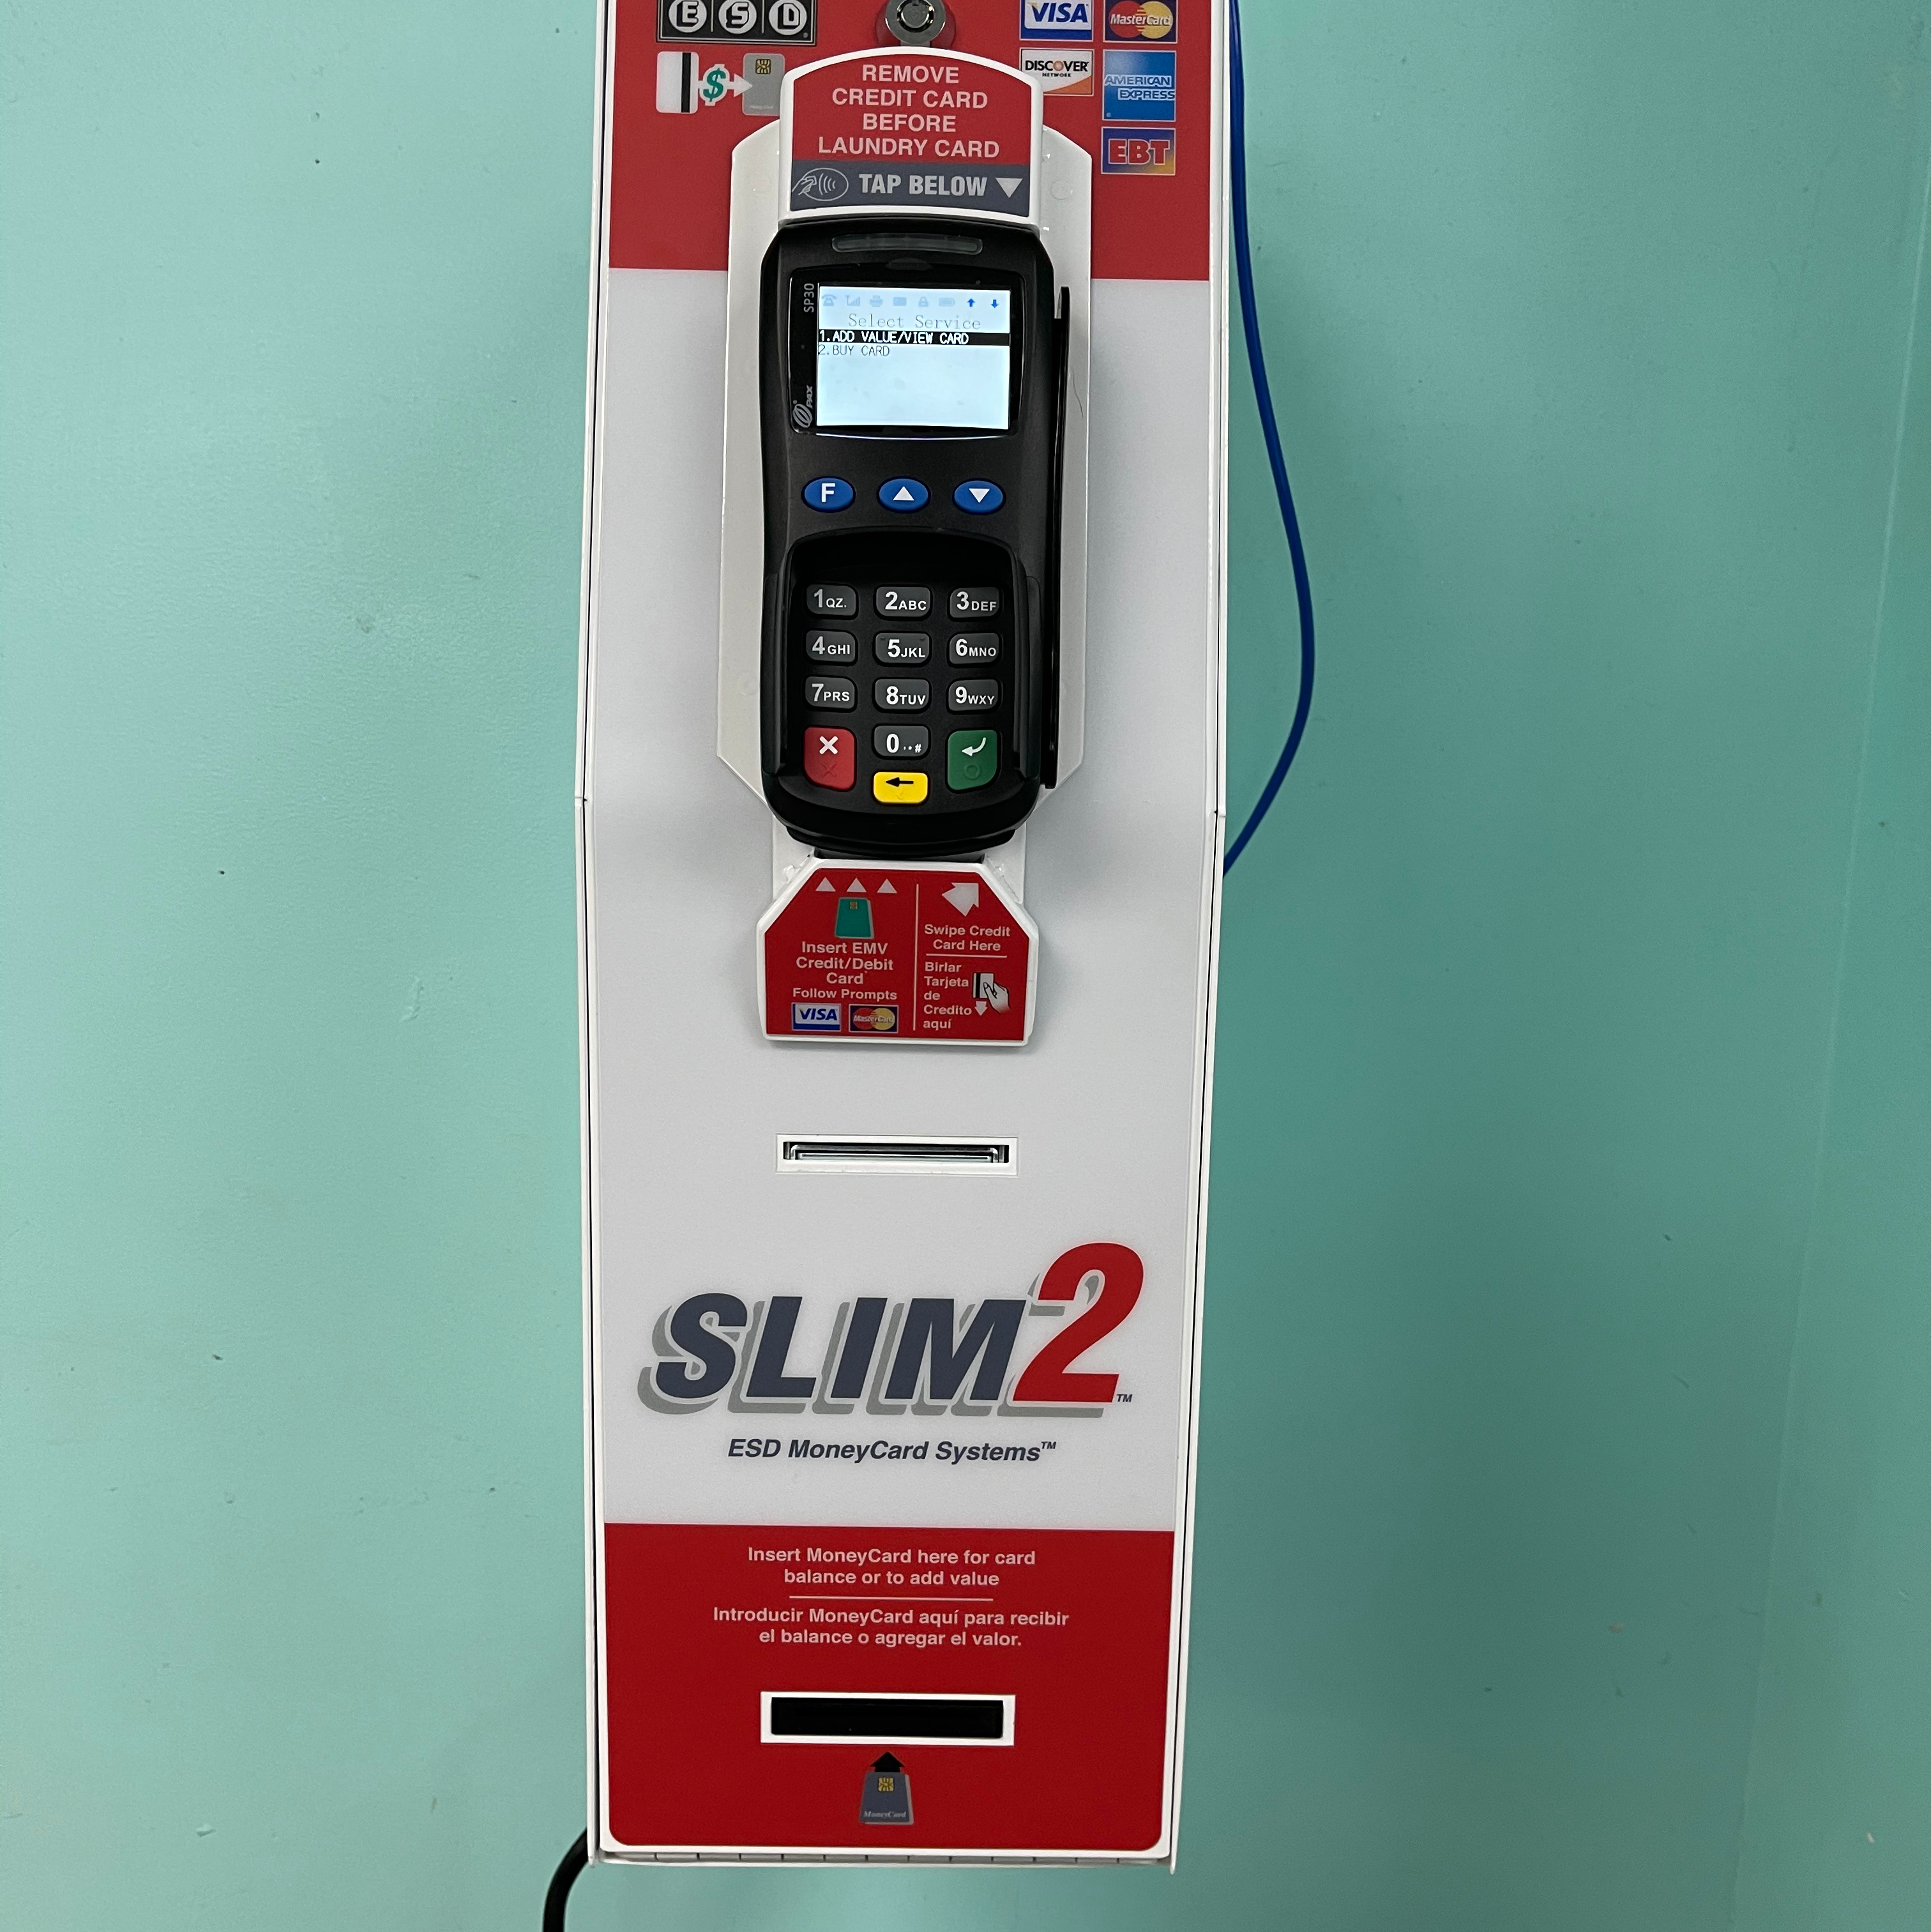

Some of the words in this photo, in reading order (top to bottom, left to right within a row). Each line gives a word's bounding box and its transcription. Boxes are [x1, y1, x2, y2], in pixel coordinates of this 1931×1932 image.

[1028, 3, 1089, 23] VISA
[1110, 13, 1172, 26] MasterCard
[1025, 60, 1089, 72] DISCOVER
[862, 65, 959, 84] REMOVE
[1105, 75, 1171, 86] AMERICAN
[832, 88, 916, 107] CREDIT
[923, 91, 988, 109] CARD
[1119, 89, 1175, 100] EXPRESS
[863, 113, 956, 132] BEFORE
[819, 137, 927, 155] LAUNDRY
[934, 140, 999, 158] CARD
[1109, 139, 1170, 165] EBT
[859, 174, 901, 194] TAP
[909, 176, 987, 196] BELOW
[804, 283, 814, 313] SP30
[848, 313, 904, 328] Select
[915, 314, 981, 330] Service
[819, 330, 855, 343] 1.ADD
[862, 330, 933, 344] VALUE/VIEW
[940, 332, 969, 345] CARD
[818, 345, 854, 356] 2.BUY
[861, 346, 890, 356] CARD
[821, 483, 835, 503] F
[924, 924, 966, 938] Swipe
[969, 925, 1010, 937] Credit
[801, 941, 847, 954] Insert
[852, 943, 888, 955] EMV
[933, 939, 965, 951] Card
[969, 940, 1001, 952] Here
[796, 957, 893, 971] Credit/Debit
[925, 961, 962, 973] Birlar
[826, 972, 863, 985] Card
[924, 977, 969, 989] Tarjeta
[793, 987, 837, 999] Follow
[842, 989, 897, 1003] Prompts
[923, 991, 940, 1001] de
[799, 1008, 837, 1021] VISA
[923, 1005, 972, 1016] Credito
[923, 1018, 951, 1031] aquí
[728, 1438, 781, 1457] ESD
[788, 1439, 929, 1464] MoneyCard
[748, 1547, 801, 1563] Insert
[806, 1548, 912, 1566] MoneyCard
[918, 1549, 958, 1564] here
[964, 1550, 989, 1564] for
[994, 1551, 1036, 1565] card
[784, 1569, 856, 1584] balance
[862, 1573, 881, 1585] or
[886, 1572, 904, 1585] to
[910, 1571, 944, 1585] add
[950, 1572, 1000, 1586] value
[713, 1607, 804, 1622] Introducir
[809, 1608, 914, 1627] MoneyCard
[919, 1610, 959, 1628] aquí
[964, 1613, 1004, 1629] para
[1010, 1611, 1069, 1626] recibir
[759, 1629, 775, 1643] el
[781, 1629, 852, 1644] balance
[858, 1633, 870, 1644] o
[875, 1633, 945, 1648] agregar
[950, 1631, 967, 1645] el
[973, 1631, 1022, 1646] valor.
